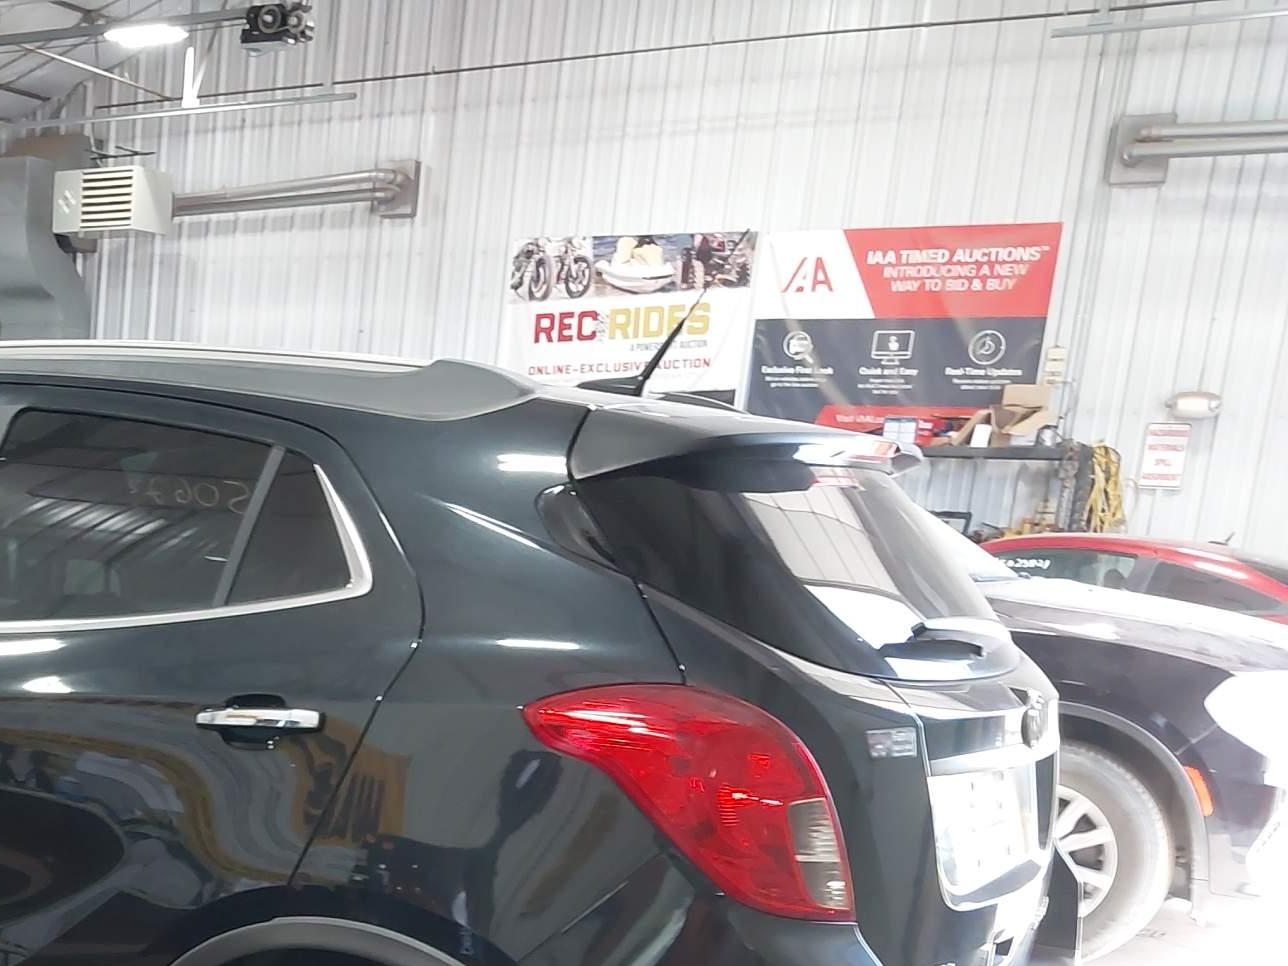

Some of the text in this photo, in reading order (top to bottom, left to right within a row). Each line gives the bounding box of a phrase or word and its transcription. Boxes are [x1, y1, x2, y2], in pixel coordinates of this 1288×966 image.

[866, 251, 897, 265] IAA
[901, 249, 949, 264] TIMED
[883, 263, 1029, 279] INTRODUCING A NEW
[890, 278, 1016, 292] WAY TO BID & BUY
[534, 310, 599, 344] REC
[608, 303, 711, 340] RIDES
